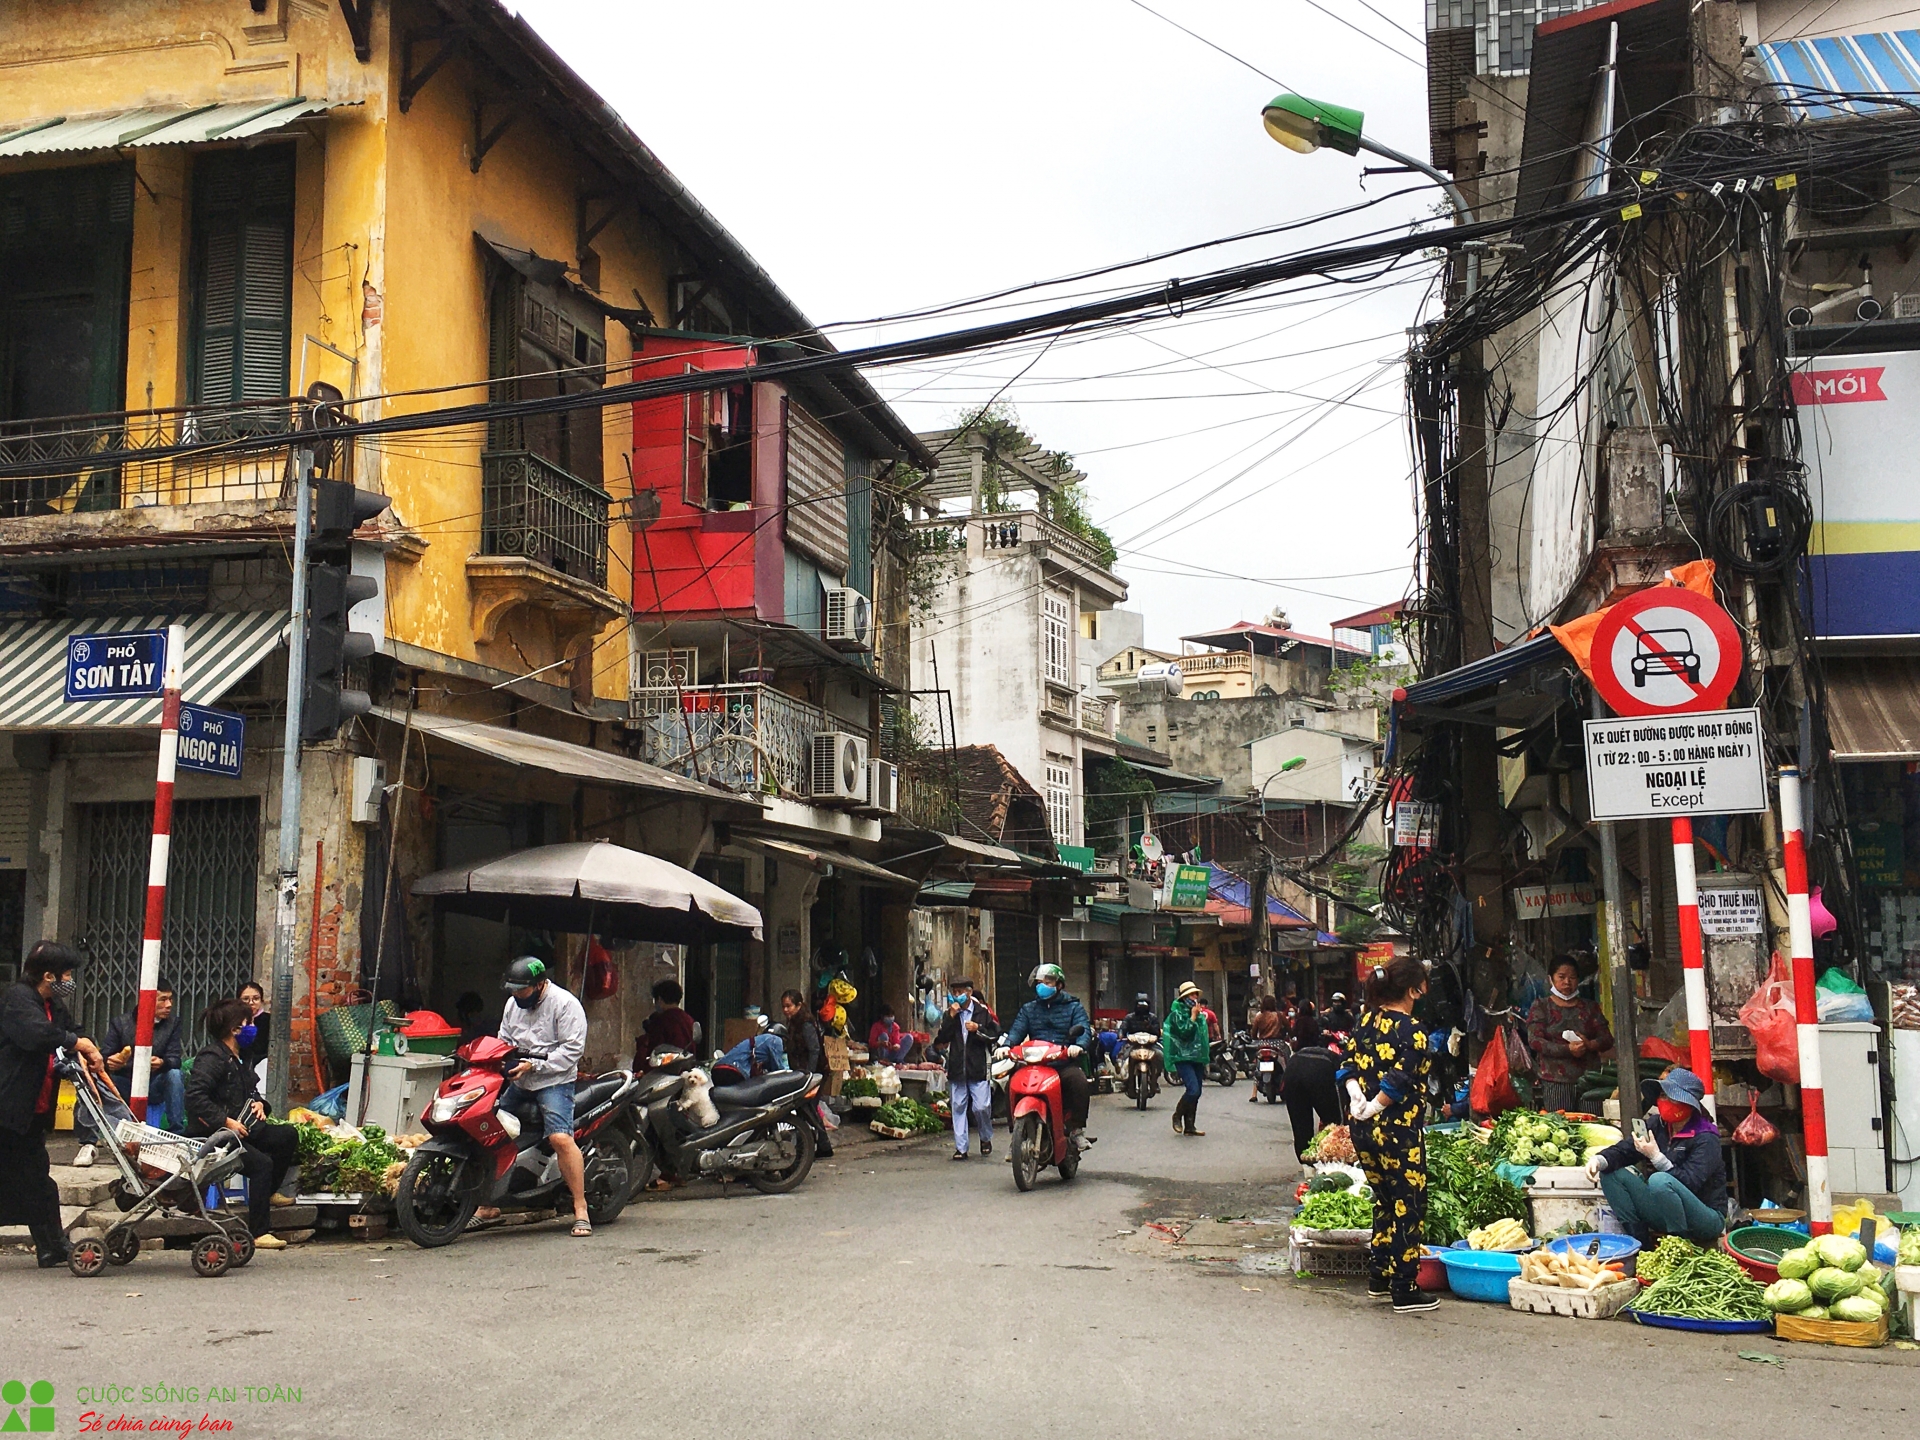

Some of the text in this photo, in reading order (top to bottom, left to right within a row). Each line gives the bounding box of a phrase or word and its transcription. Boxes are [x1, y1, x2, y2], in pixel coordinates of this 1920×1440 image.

[1815, 373, 1866, 396] MỚI
[107, 641, 137, 659] PHỐ
[74, 659, 155, 690] SƠN TÂY
[203, 721, 224, 735] PHỐ
[1592, 720, 1753, 744] XE QUÉT ĐƯỜNG ĐƯỢC HOẠT ĐỘNG
[178, 735, 238, 767] NGỌC HÀ
[1603, 750, 1616, 765] TỪ
[1688, 744, 1715, 760] HÀNG
[1717, 742, 1744, 758] NGÀY
[1646, 767, 1706, 790] NGOẠI LỆ
[1651, 791, 1704, 809] Except
[1698, 894, 1716, 908] CHO
[1718, 891, 1740, 908] THUÊ
